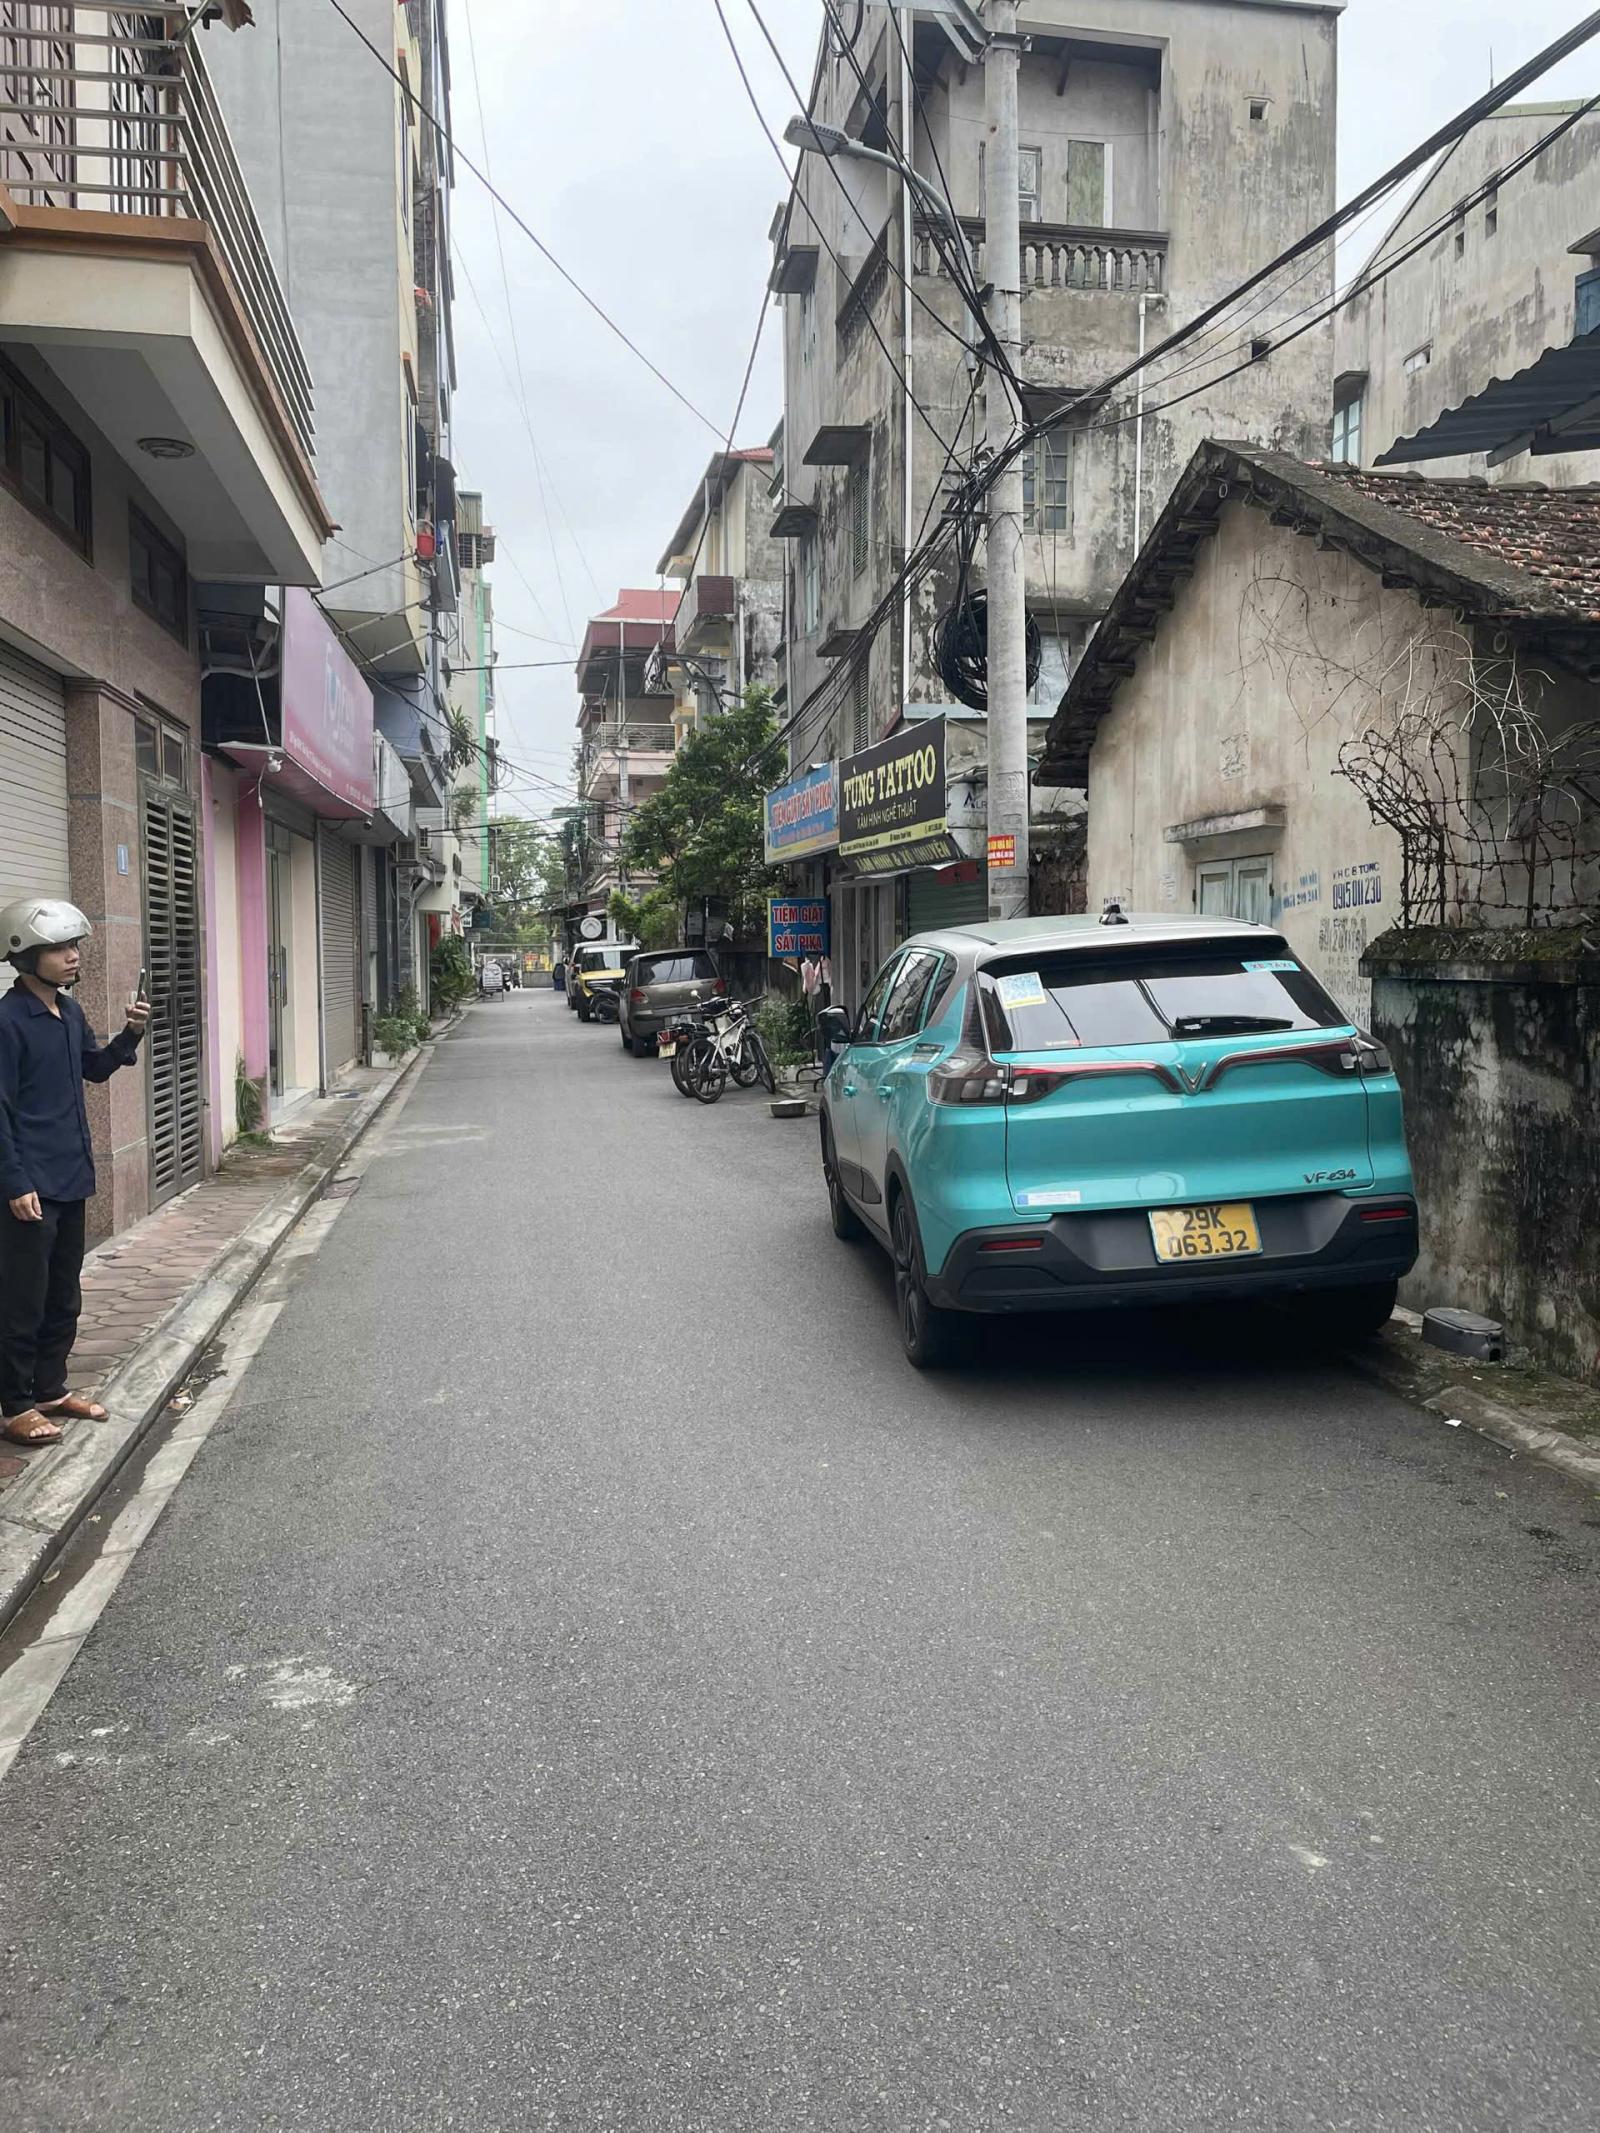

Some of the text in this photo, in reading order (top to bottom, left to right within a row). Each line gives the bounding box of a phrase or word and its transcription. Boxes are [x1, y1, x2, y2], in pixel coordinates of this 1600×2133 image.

[843, 744, 936, 811] TÙNG TATTOO
[772, 903, 799, 927] TIỆM
[775, 929, 823, 952] SẤY PIKA
[1182, 1207, 1226, 1232] 29K
[1168, 1229, 1250, 1258] 063.32
